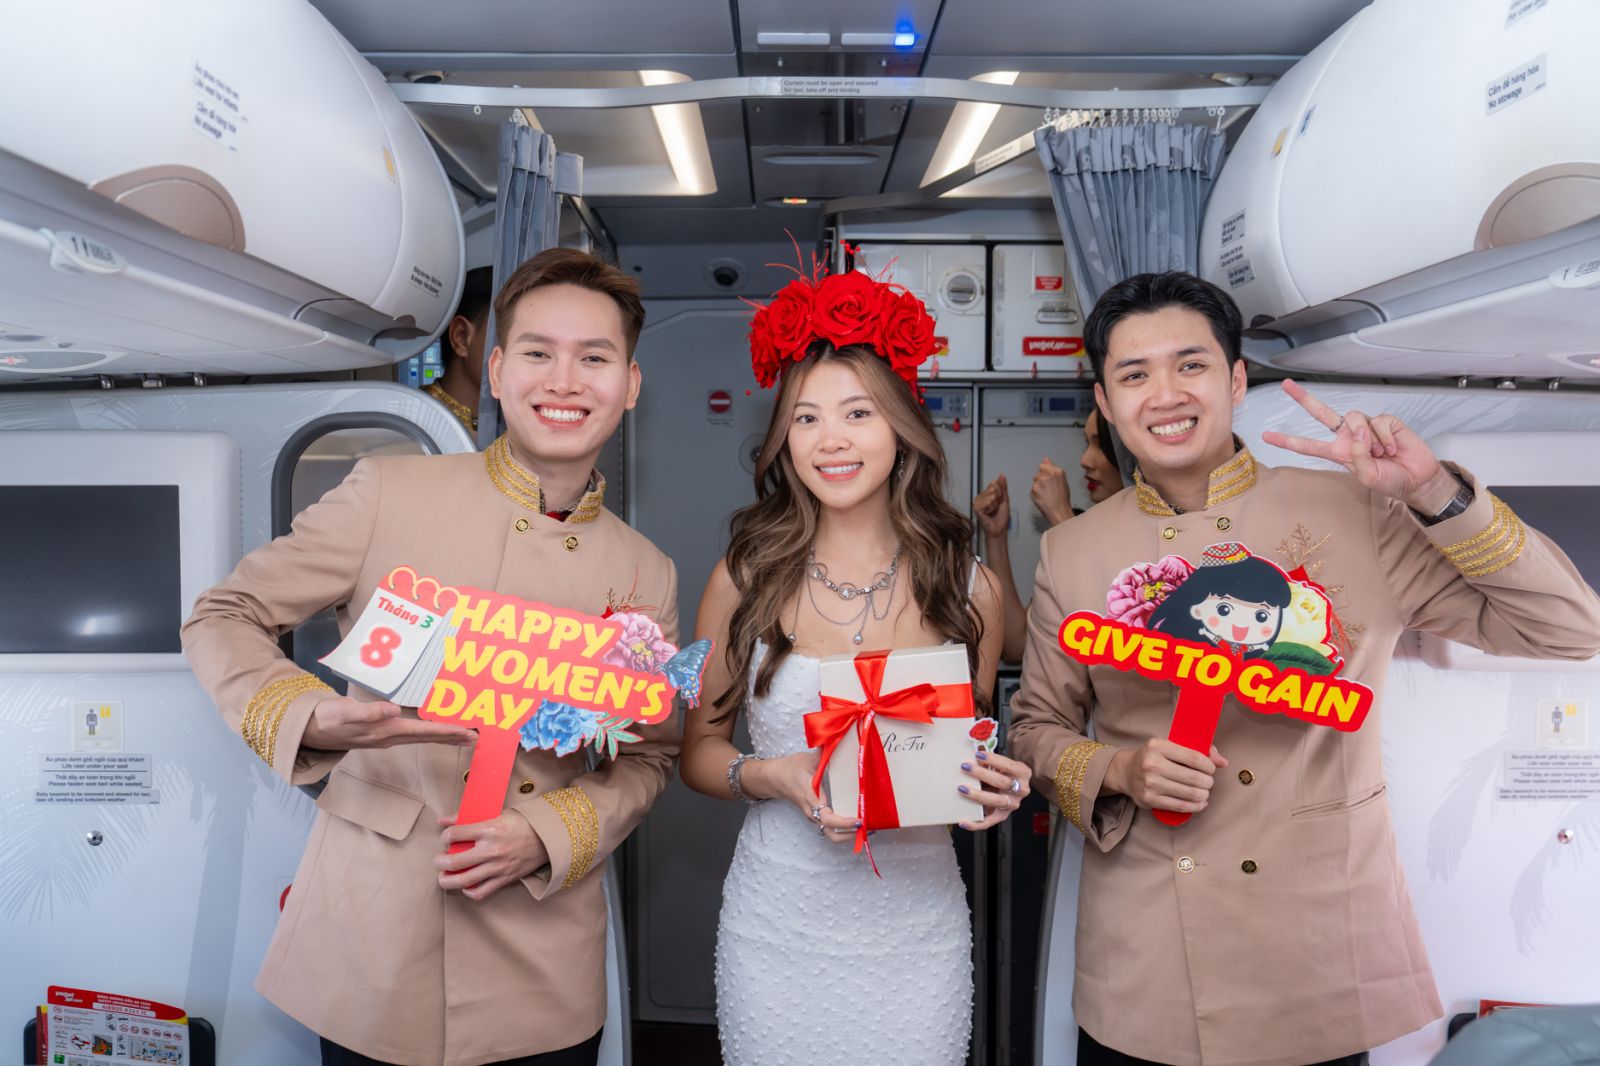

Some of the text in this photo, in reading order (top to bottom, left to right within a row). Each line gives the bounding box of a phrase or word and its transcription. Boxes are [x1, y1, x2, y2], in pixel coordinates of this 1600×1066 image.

[1498, 87, 1522, 105] stowage
[377, 596, 434, 630] Tháng 3
[450, 595, 616, 658] HAPPY
[359, 626, 402, 669] 8
[1062, 618, 1361, 722] GIVE TO GAIN
[443, 636, 666, 717] WOMEN'S
[425, 680, 534, 730] DAY
